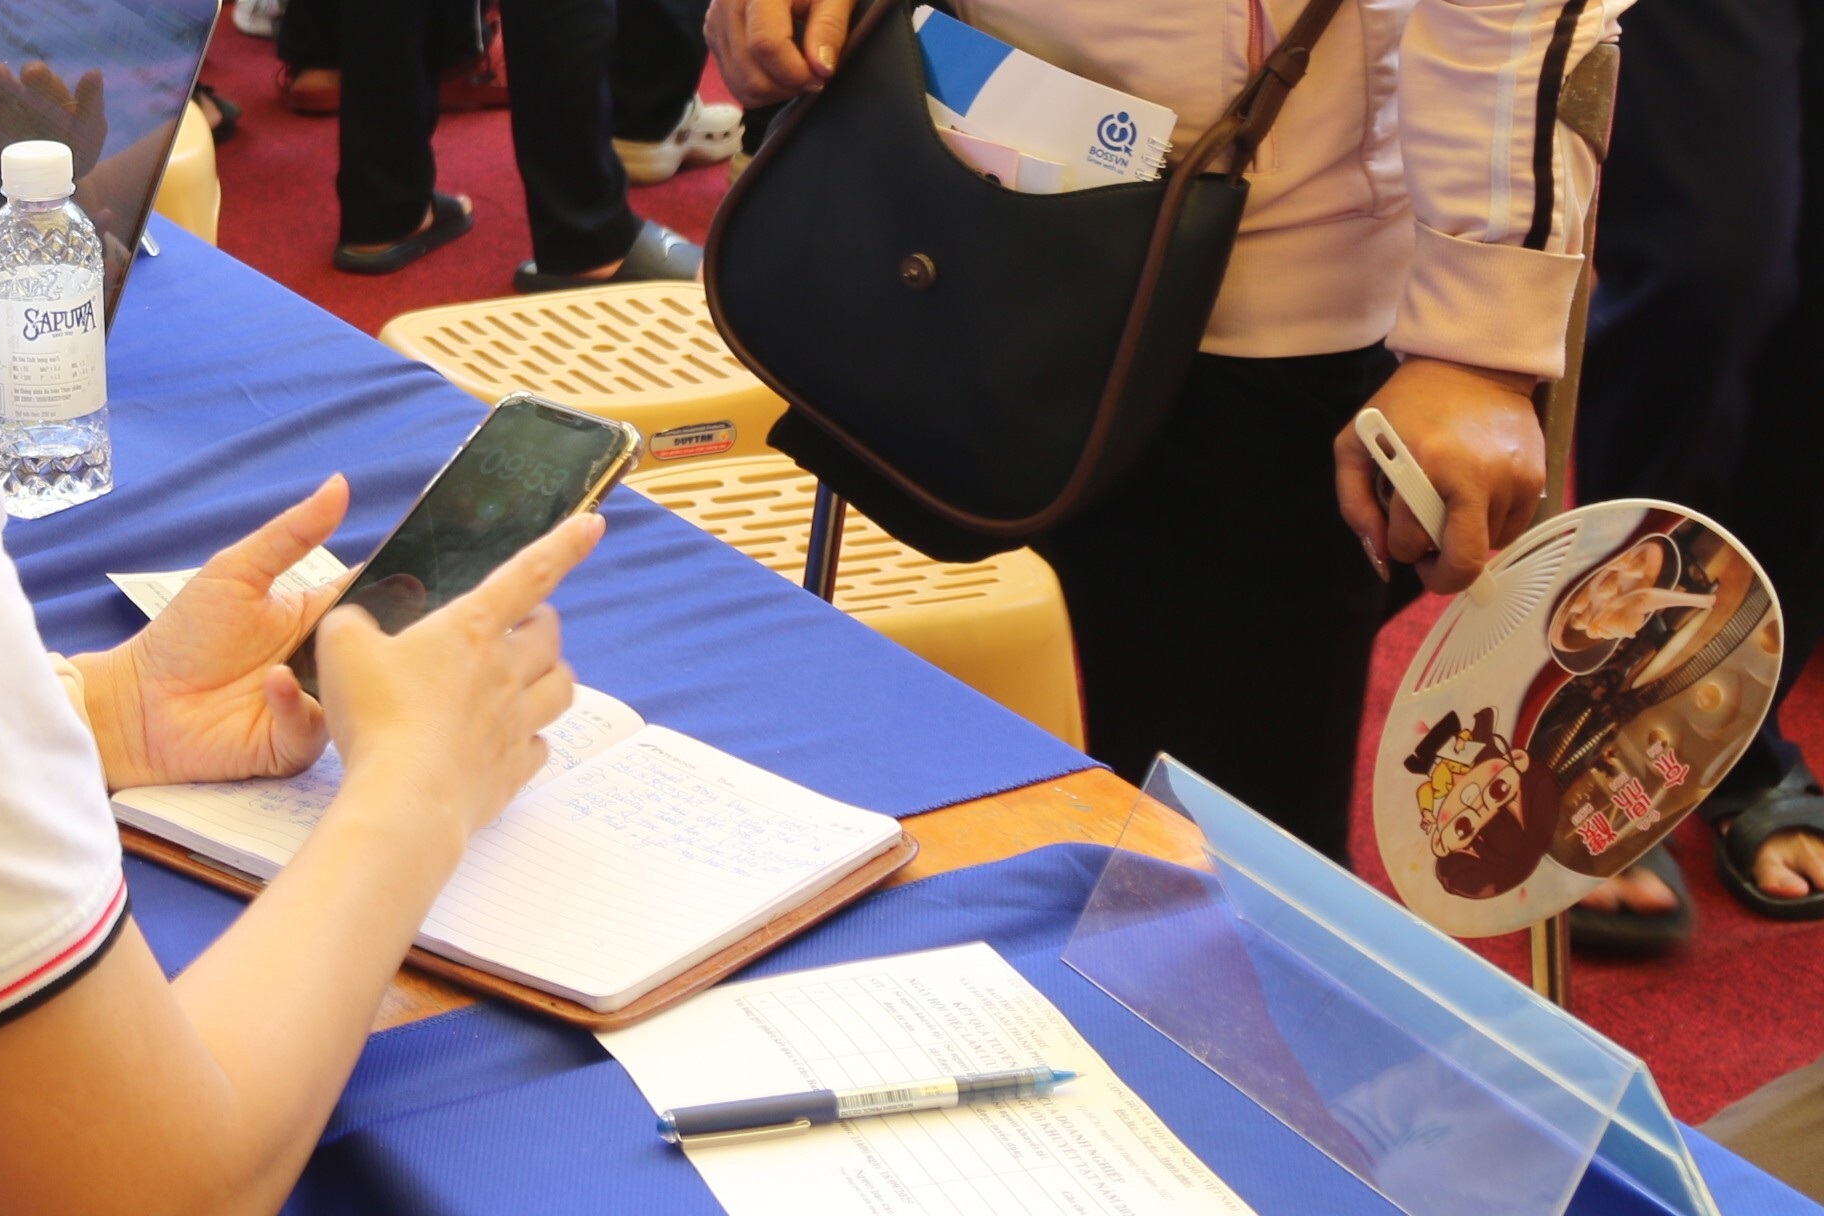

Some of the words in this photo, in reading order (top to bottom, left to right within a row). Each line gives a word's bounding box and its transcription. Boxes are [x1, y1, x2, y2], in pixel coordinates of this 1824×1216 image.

[1089, 145, 1129, 168] BOSSVN
[23, 300, 97, 342] SAPUWA
[480, 448, 570, 496] 09:53
